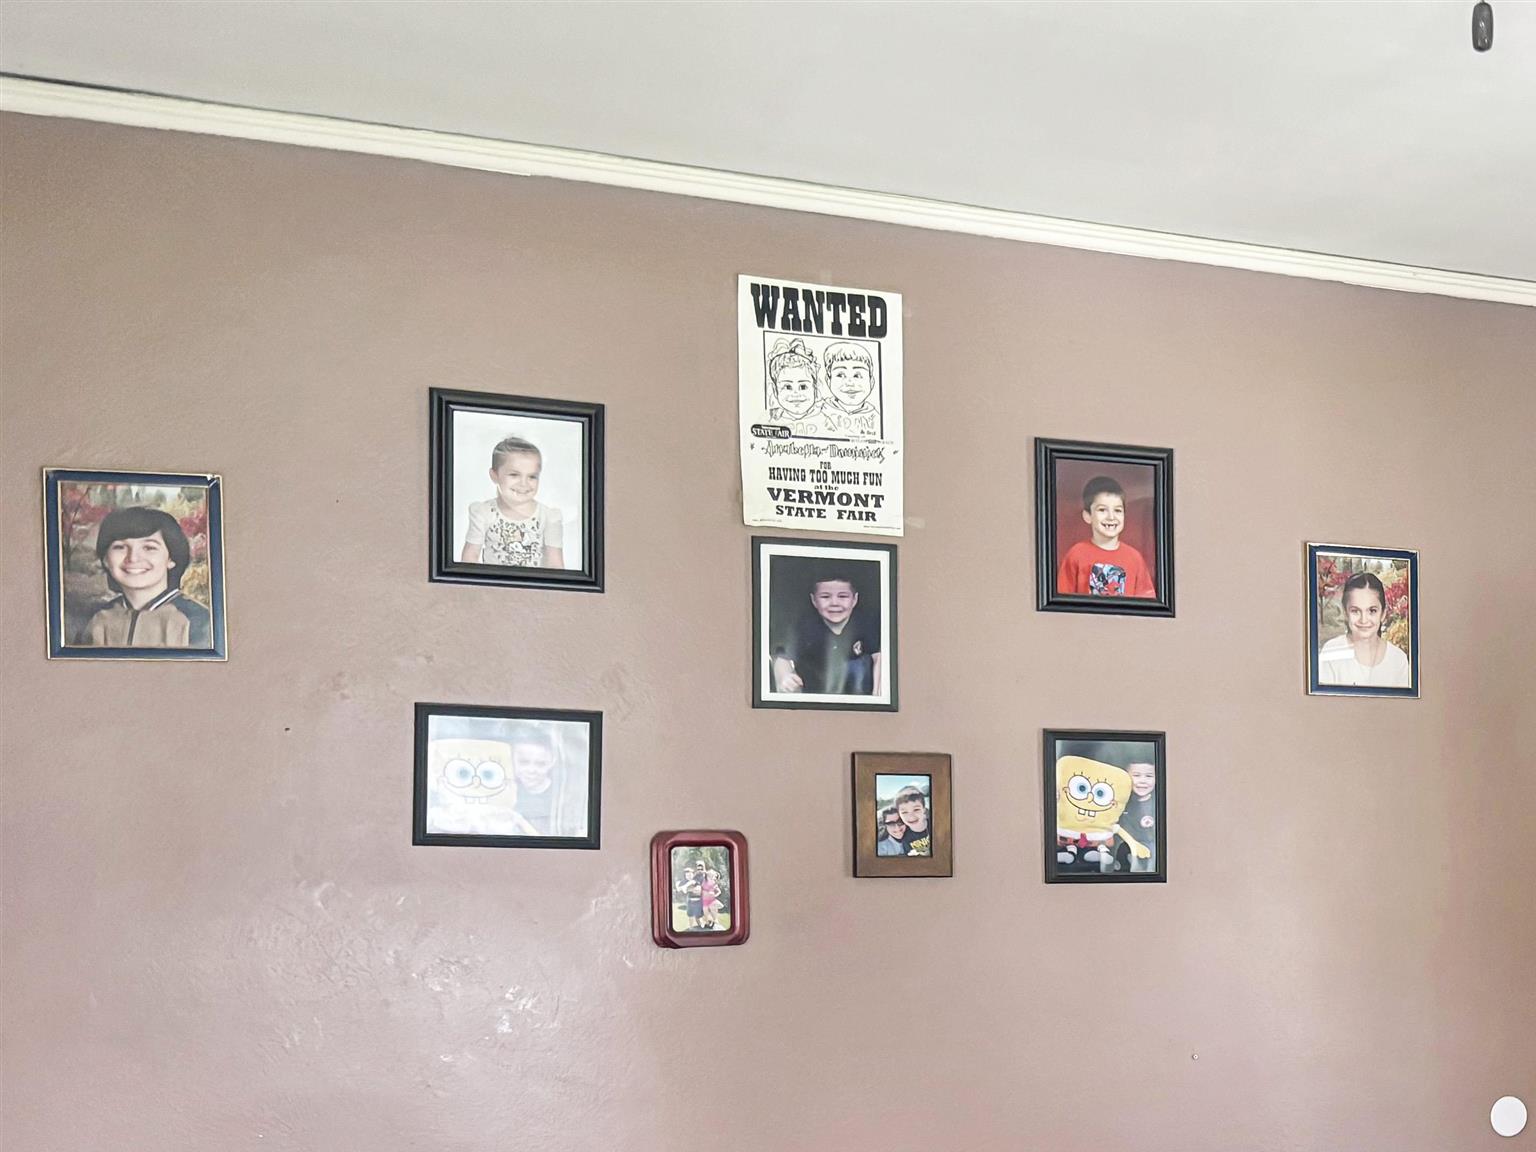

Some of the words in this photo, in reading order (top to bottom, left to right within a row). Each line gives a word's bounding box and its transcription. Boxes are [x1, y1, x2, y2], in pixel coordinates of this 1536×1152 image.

[750, 282, 888, 339] WANTED
[820, 461, 831, 469] FOR
[768, 467, 806, 482] HAVING
[809, 469, 828, 484] TOO
[831, 471, 860, 486] MUCH
[863, 472, 883, 486] FUN
[767, 487, 885, 508] VERMONT
[776, 505, 827, 518] STATE
[837, 509, 877, 522] FAIR
